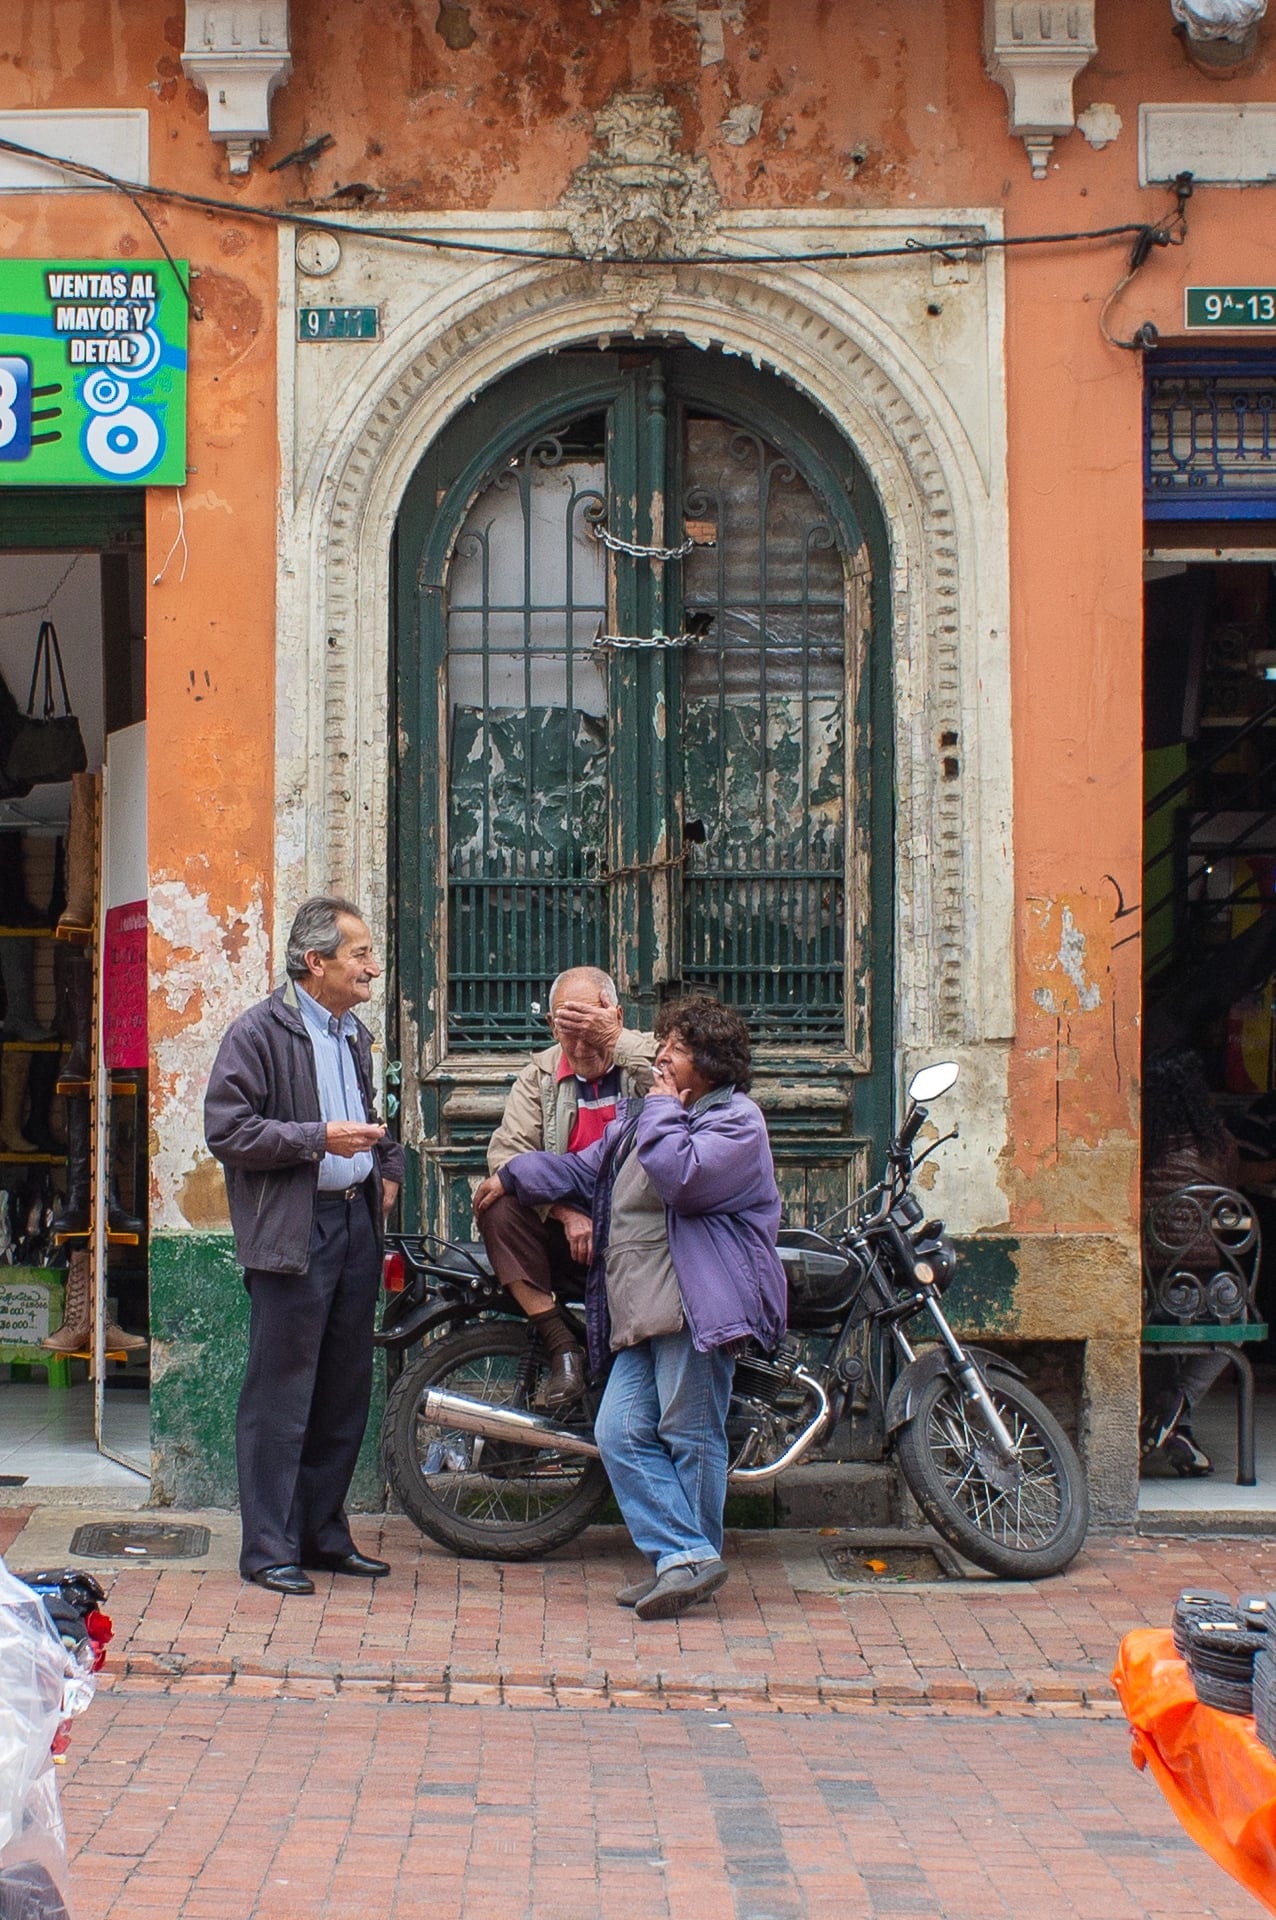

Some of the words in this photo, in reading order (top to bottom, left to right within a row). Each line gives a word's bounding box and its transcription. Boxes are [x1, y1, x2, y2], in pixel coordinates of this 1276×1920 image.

[48, 274, 127, 298] VENTAS
[130, 275, 155, 298] AL
[56, 307, 128, 331] MAYOR
[133, 307, 147, 331] Y
[1204, 294, 1275, 321] 9A-13
[70, 339, 131, 363] DETAL
